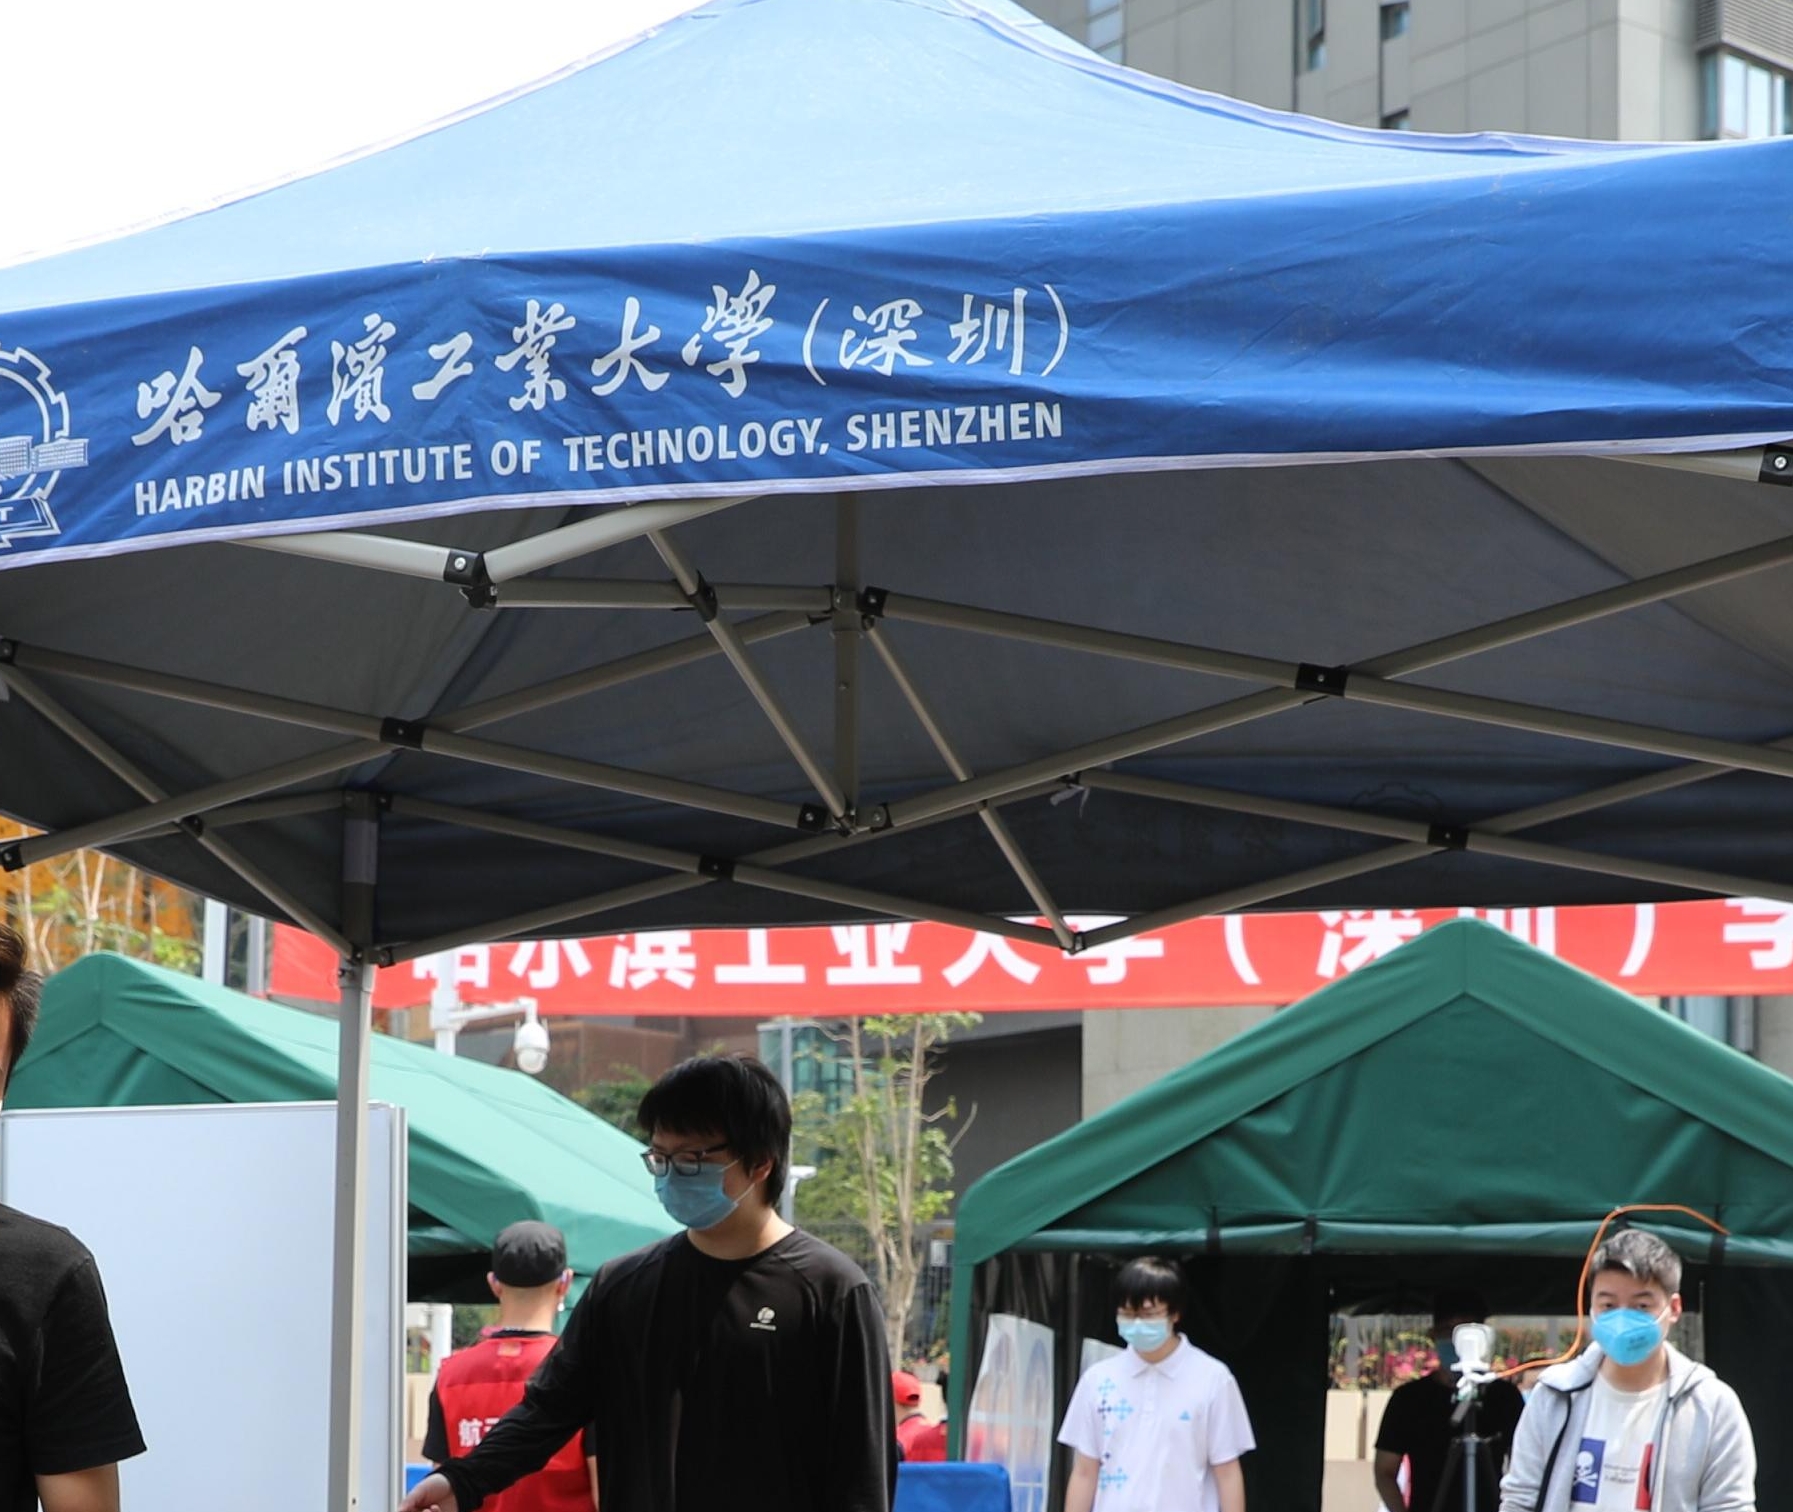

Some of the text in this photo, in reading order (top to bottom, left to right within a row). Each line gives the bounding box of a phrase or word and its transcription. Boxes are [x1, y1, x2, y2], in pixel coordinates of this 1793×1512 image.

[135, 402, 1063, 516] HARBIN INSTITUTE OF TECHNOLOGY, SHENZHEN
